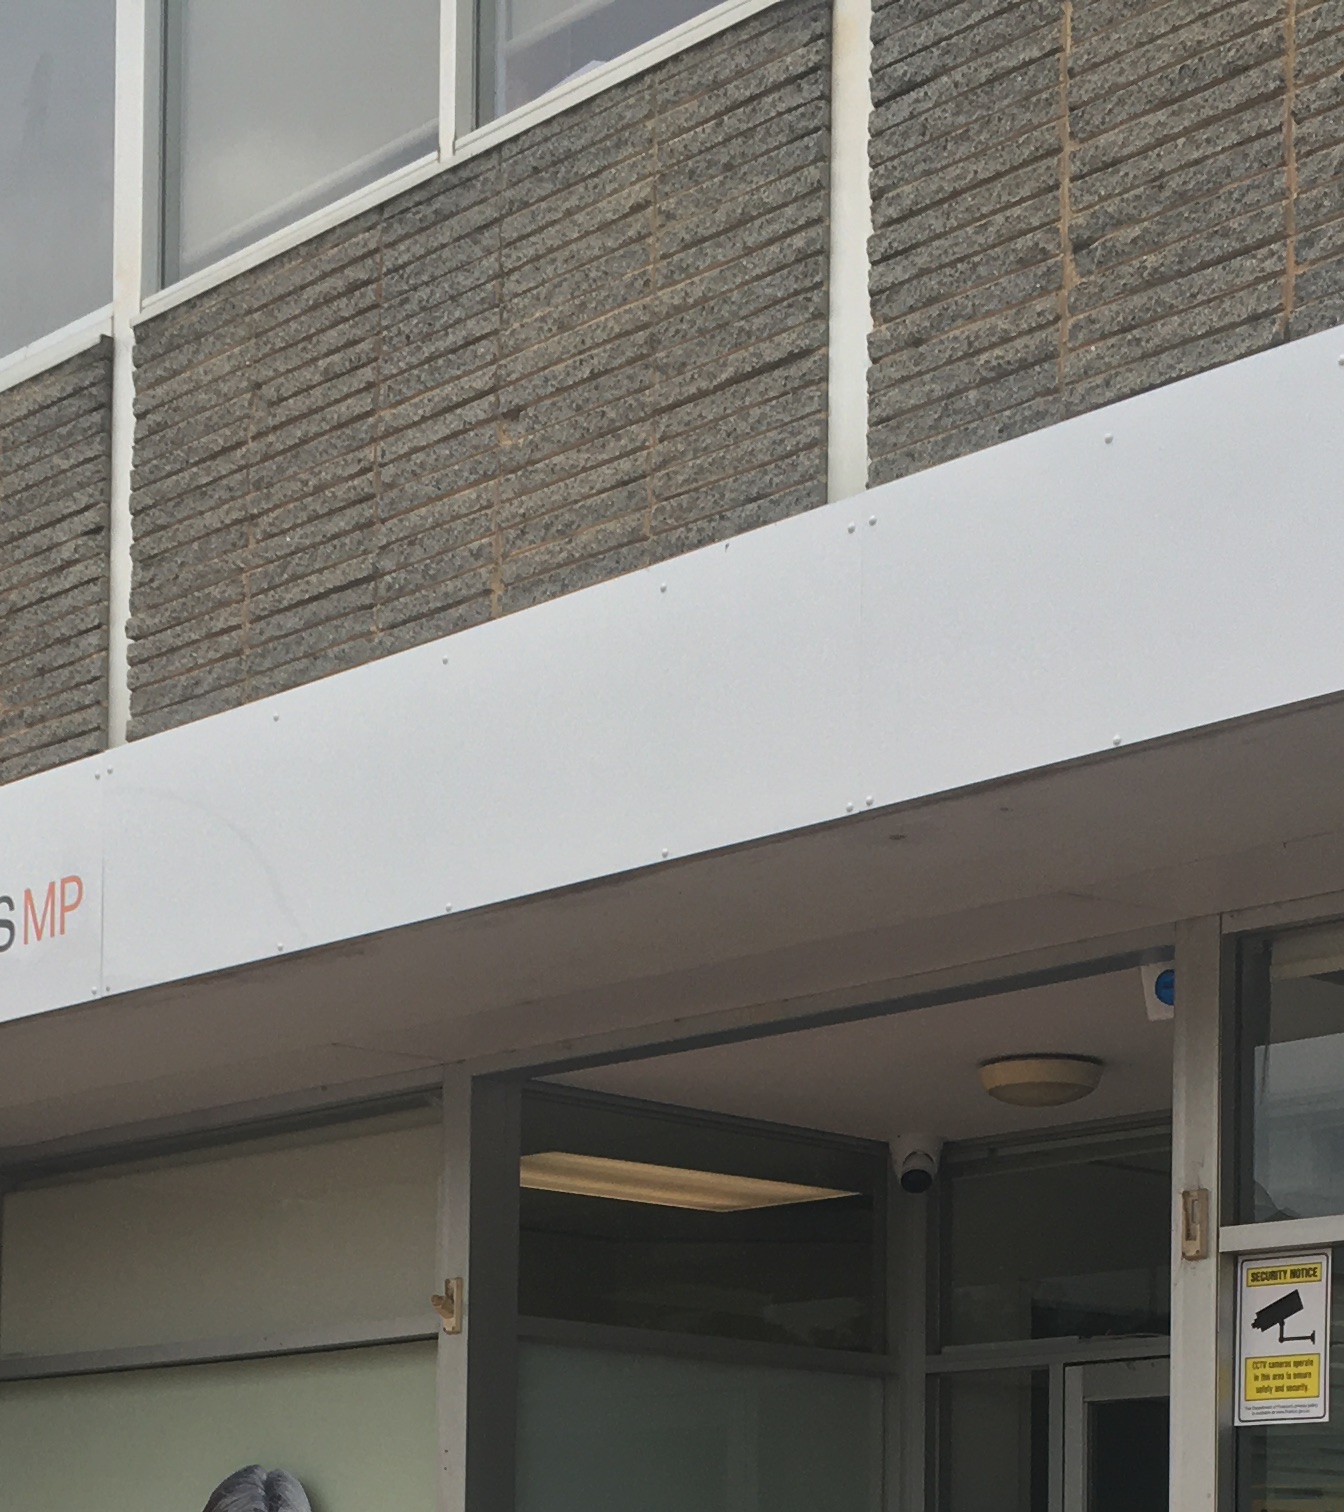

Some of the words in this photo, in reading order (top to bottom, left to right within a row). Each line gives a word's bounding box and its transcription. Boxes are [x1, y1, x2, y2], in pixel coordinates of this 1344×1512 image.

[23, 875, 84, 945] MP
[1250, 1269, 1288, 1282] SECURITY
[1289, 1267, 1318, 1280] NOTICE
